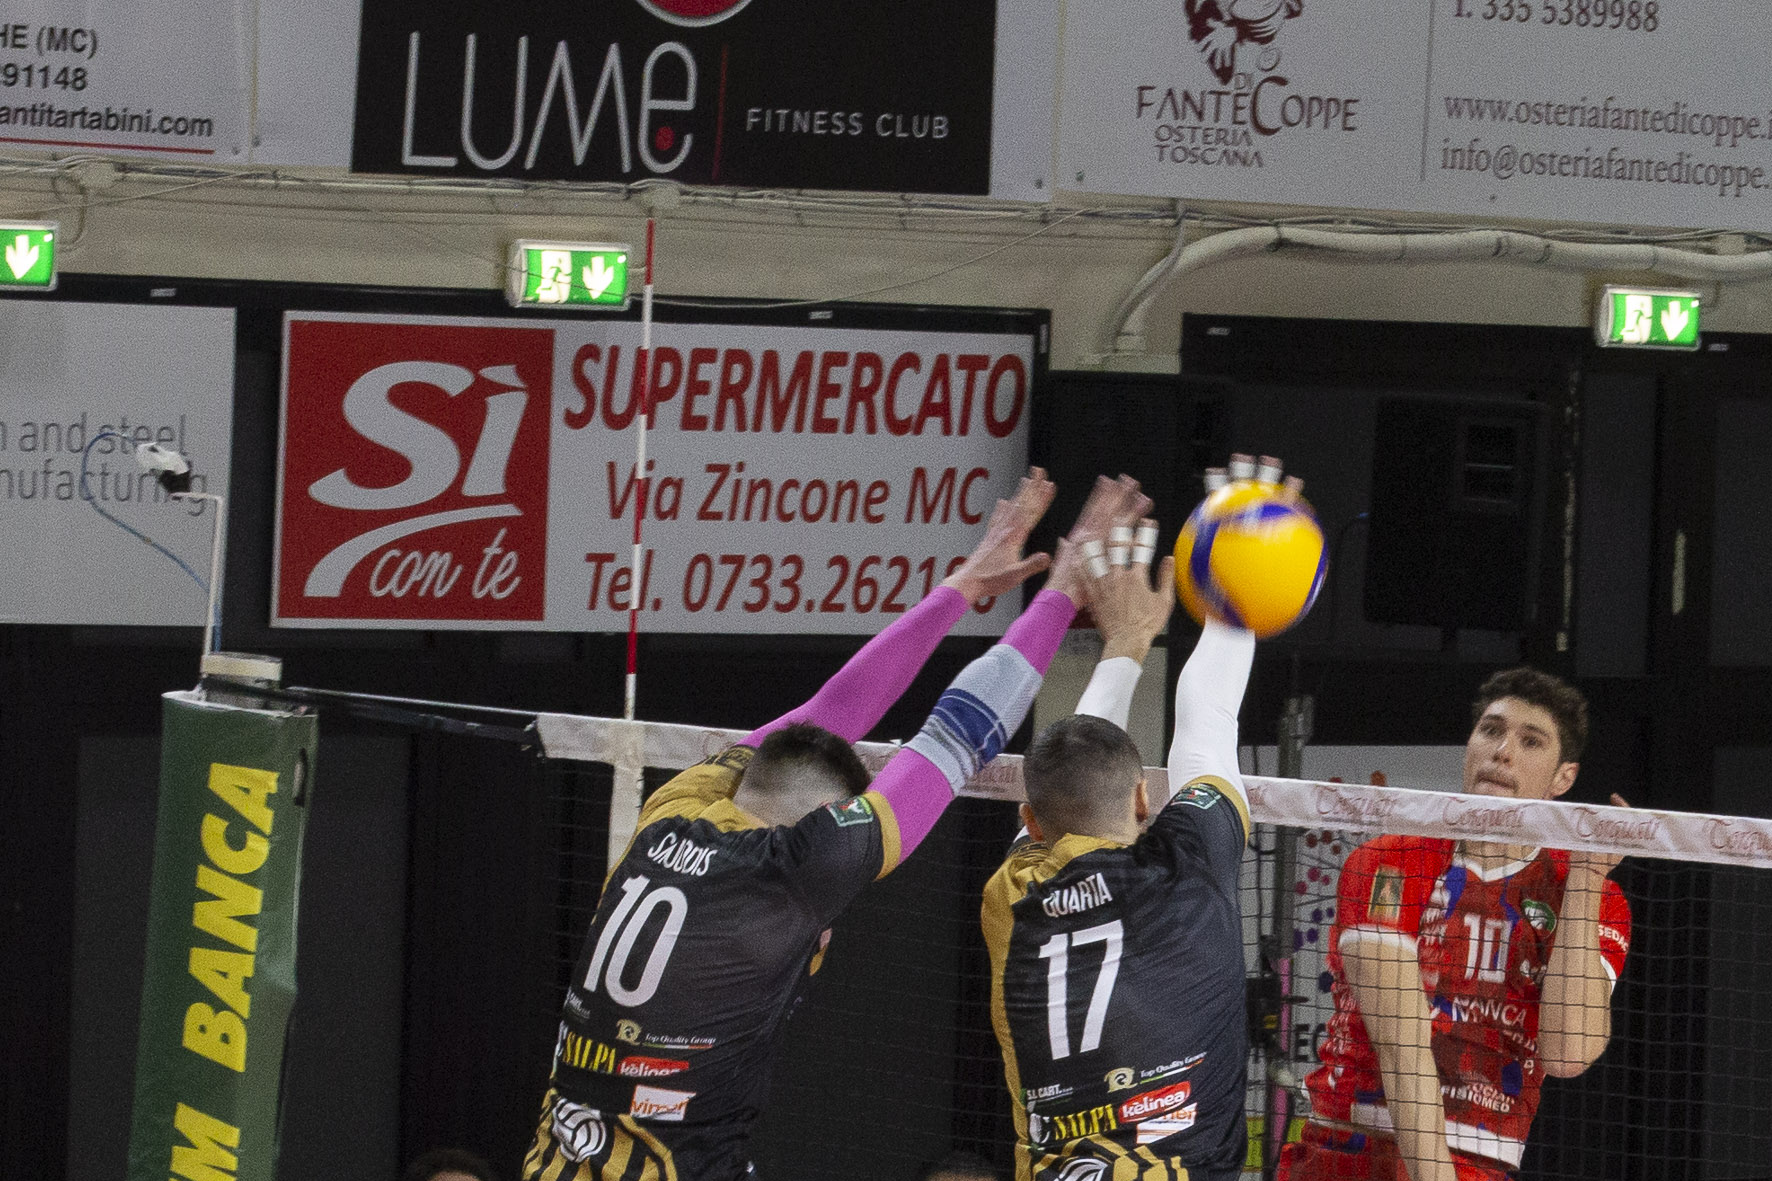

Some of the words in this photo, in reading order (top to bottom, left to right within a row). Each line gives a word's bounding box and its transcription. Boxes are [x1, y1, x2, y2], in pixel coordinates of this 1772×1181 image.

[36, 25, 98, 60] (MC)
[745, 106, 864, 137] FITNESS
[875, 112, 950, 141] CLUB
[1153, 123, 1254, 147] OSTERIA
[1153, 144, 1264, 169] TOSCANA
[563, 342, 1028, 439] SUPERMERCATO
[18, 411, 88, 456] and
[98, 413, 190, 457] steel
[606, 460, 684, 523] Via
[696, 460, 892, 525] Zincone
[904, 465, 990, 526] MC
[368, 543, 463, 598] con
[470, 526, 523, 599] te
[584, 548, 662, 614] Tel.
[682, 552, 998, 616] 0733.2621
[181, 761, 280, 1073] BANCA
[1042, 872, 1113, 918] QUARTA
[583, 873, 689, 1008] 10
[1463, 913, 1513, 984] 10
[1038, 918, 1125, 1061] 17
